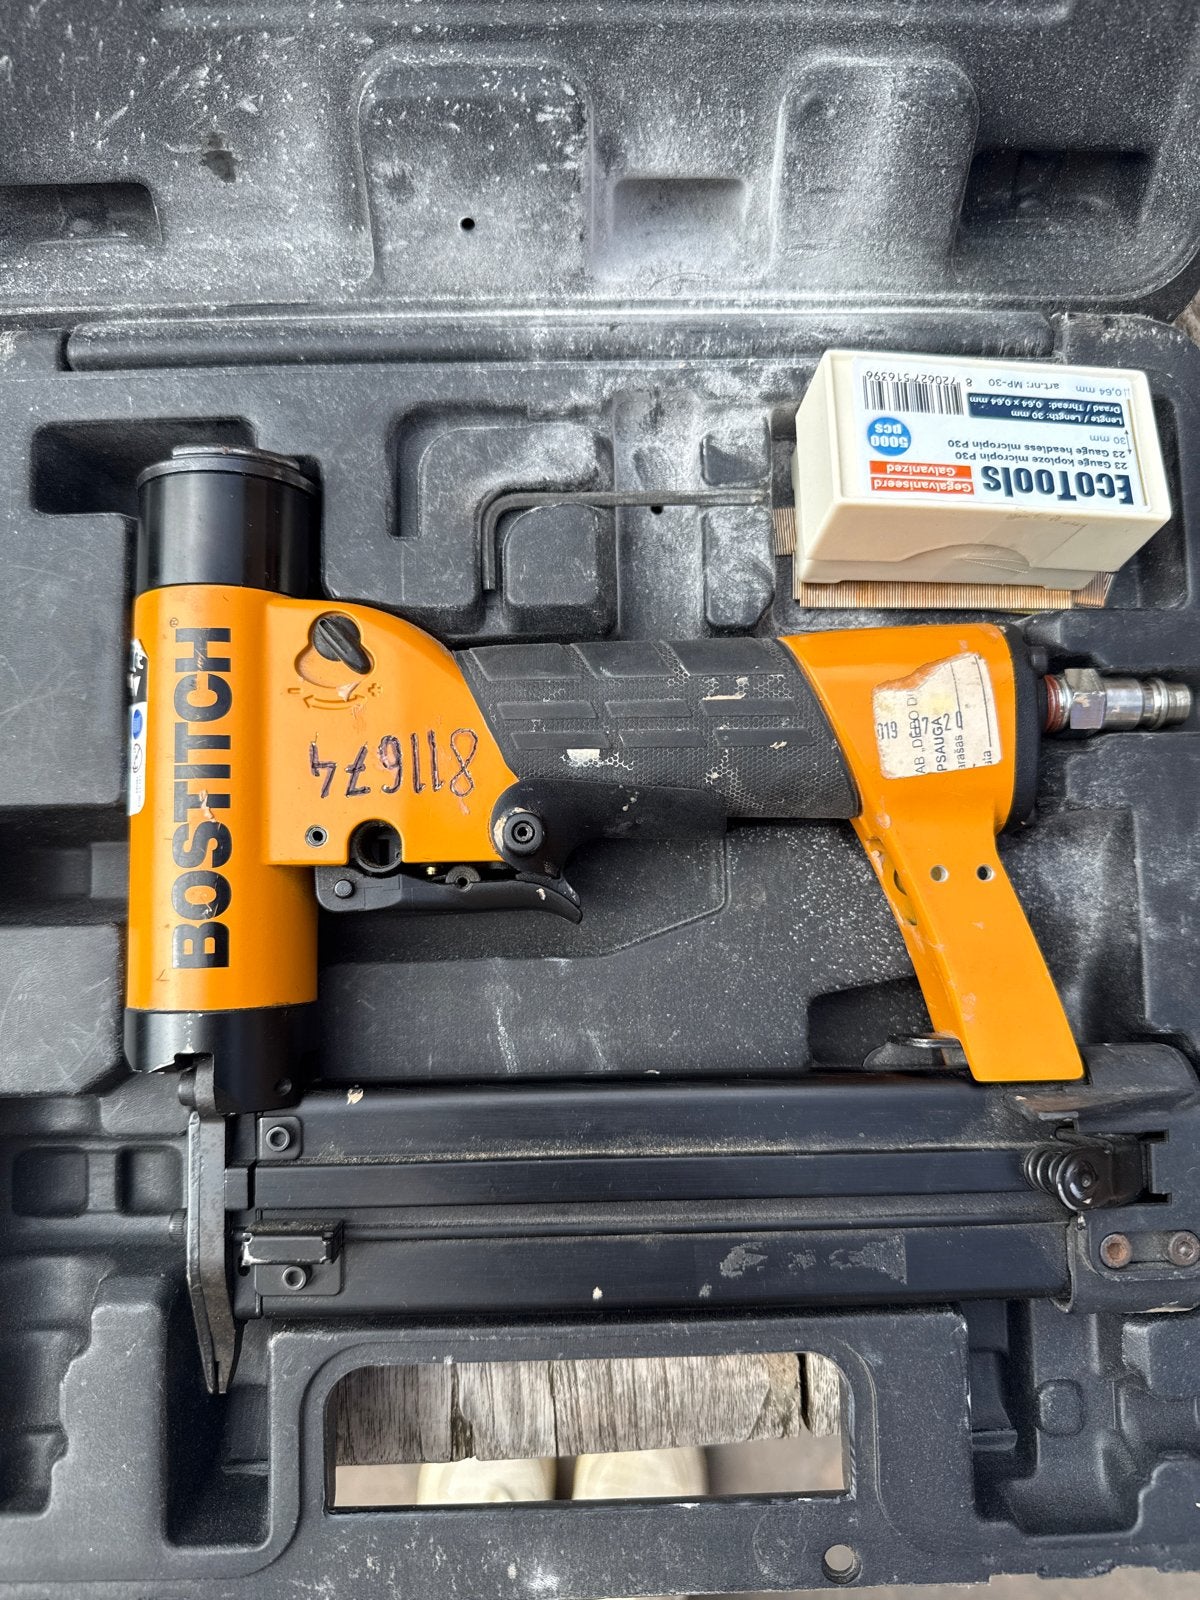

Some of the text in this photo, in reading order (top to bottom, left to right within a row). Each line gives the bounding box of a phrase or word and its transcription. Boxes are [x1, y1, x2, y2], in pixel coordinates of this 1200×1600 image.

[966, 378, 973, 387] 8
[989, 378, 1122, 396] 0,64 mm art.nr: MP-30
[969, 396, 988, 404] mm
[990, 396, 1011, 406] 0,64
[1021, 398, 1042, 408] 0,64
[1049, 402, 1084, 412] Thread:
[1093, 405, 1121, 414] Draad
[1011, 410, 1029, 418] mm
[1032, 411, 1044, 419] 30
[1046, 411, 1082, 422] Length:
[1091, 414, 1122, 424] Lengte
[874, 423, 902, 436] pcs
[870, 435, 909, 448] 5000
[1090, 435, 1126, 445] 30 mm
[948, 440, 1125, 458] 23 Gauge headless micropin P30
[955, 452, 1127, 470] 23 Gauge koploze micropin P30
[886, 464, 956, 476] Galvanized
[874, 479, 971, 493] Gegalvaniseerd
[981, 466, 1133, 505] EcoTools
[308, 728, 479, 799] 811674
[172, 627, 232, 969] BOSTITCH
